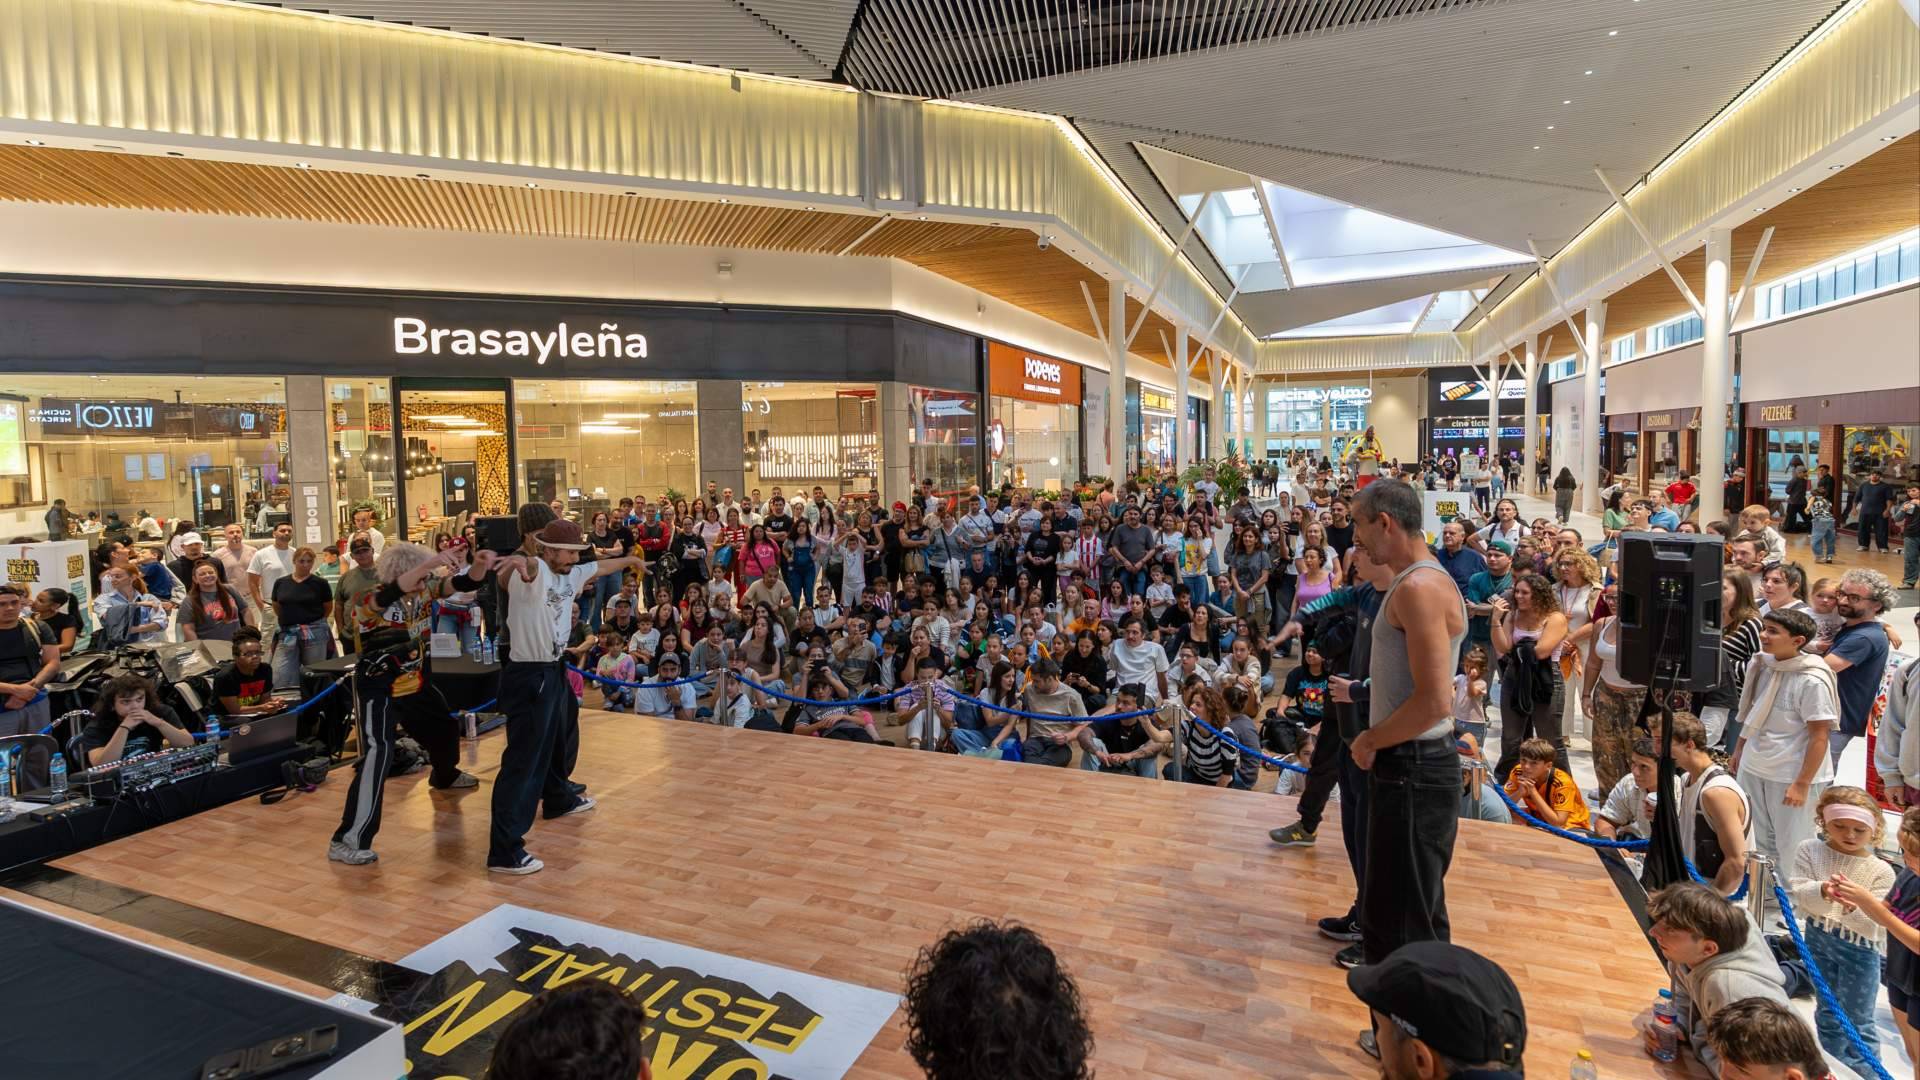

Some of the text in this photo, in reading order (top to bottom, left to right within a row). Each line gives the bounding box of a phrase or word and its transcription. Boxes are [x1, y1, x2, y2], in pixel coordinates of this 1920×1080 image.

[394, 317, 648, 365] Brasayleña
[1320, 386, 1372, 402] yelmo
[1761, 404, 1793, 421] PIZZERIE
[1451, 419, 1470, 427] cine
